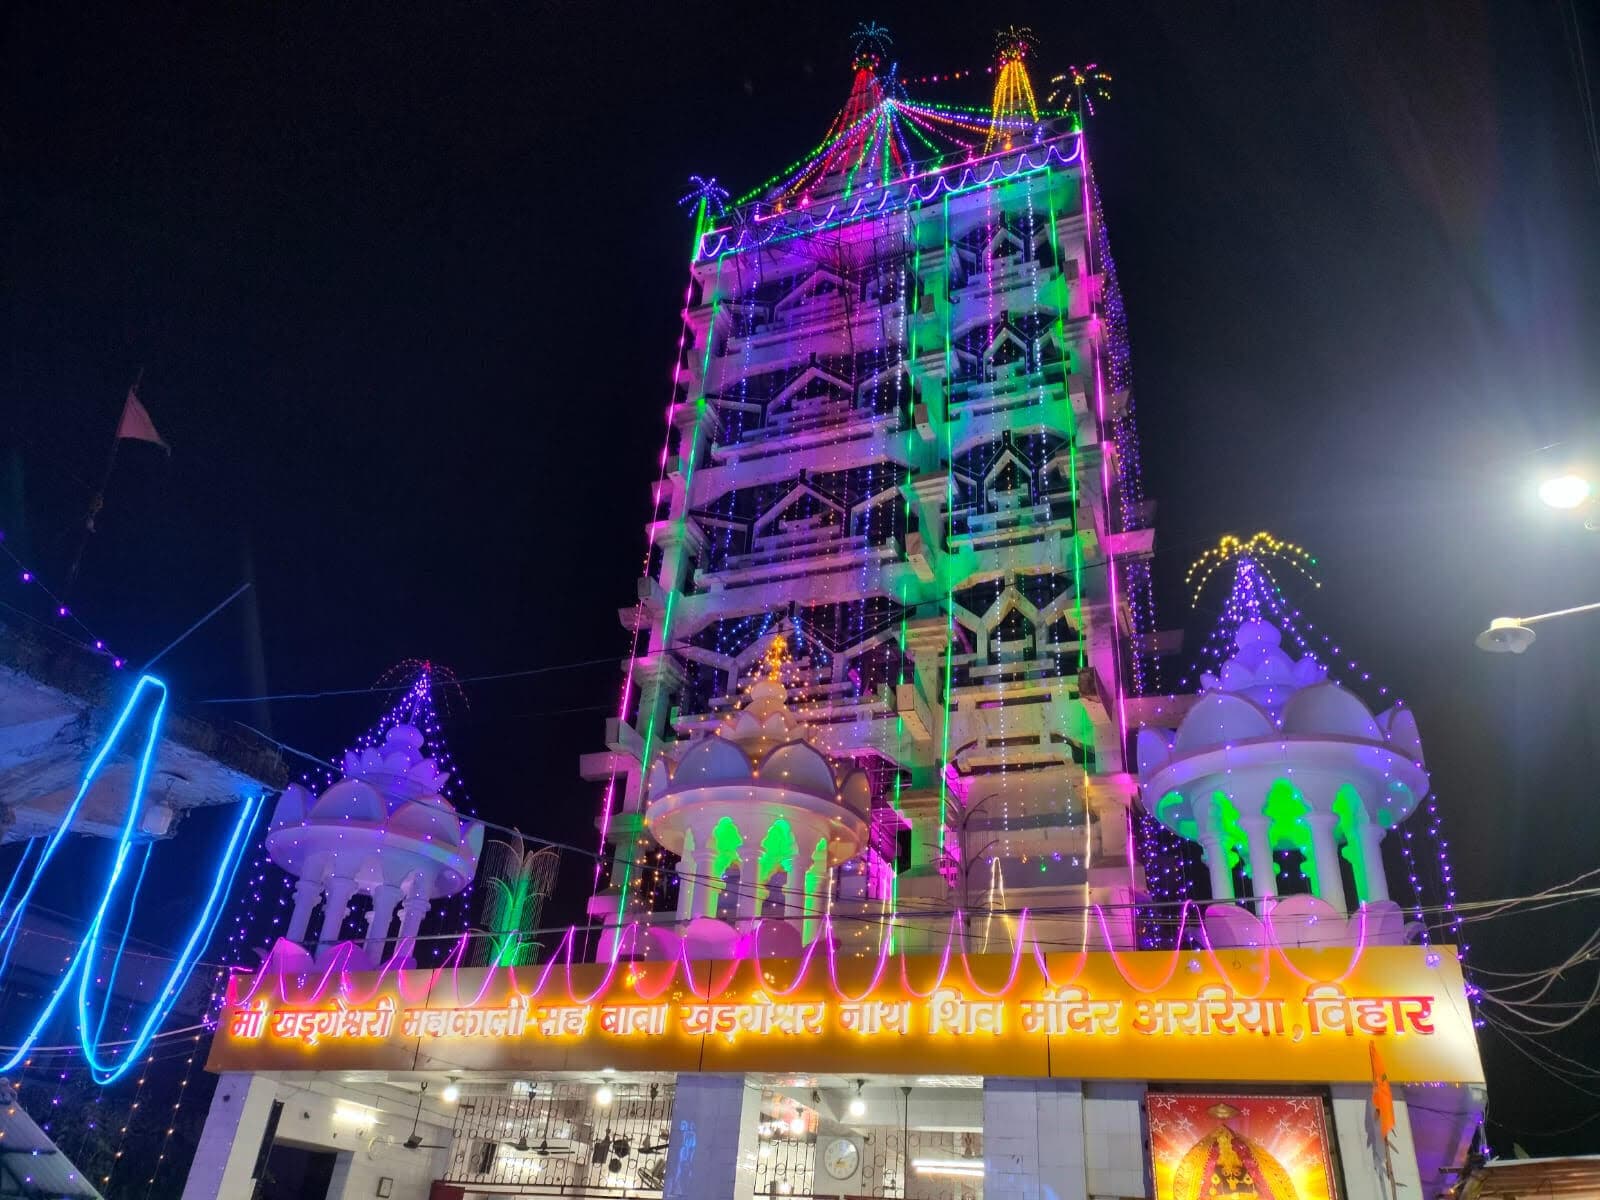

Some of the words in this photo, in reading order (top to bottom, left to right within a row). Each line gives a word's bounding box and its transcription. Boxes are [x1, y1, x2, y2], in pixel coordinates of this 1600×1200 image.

[600, 1002, 668, 1035] बाबा
[839, 1000, 910, 1035] नाथ
[928, 986, 1004, 1036] शिव
[1020, 984, 1122, 1036] मंदिर
